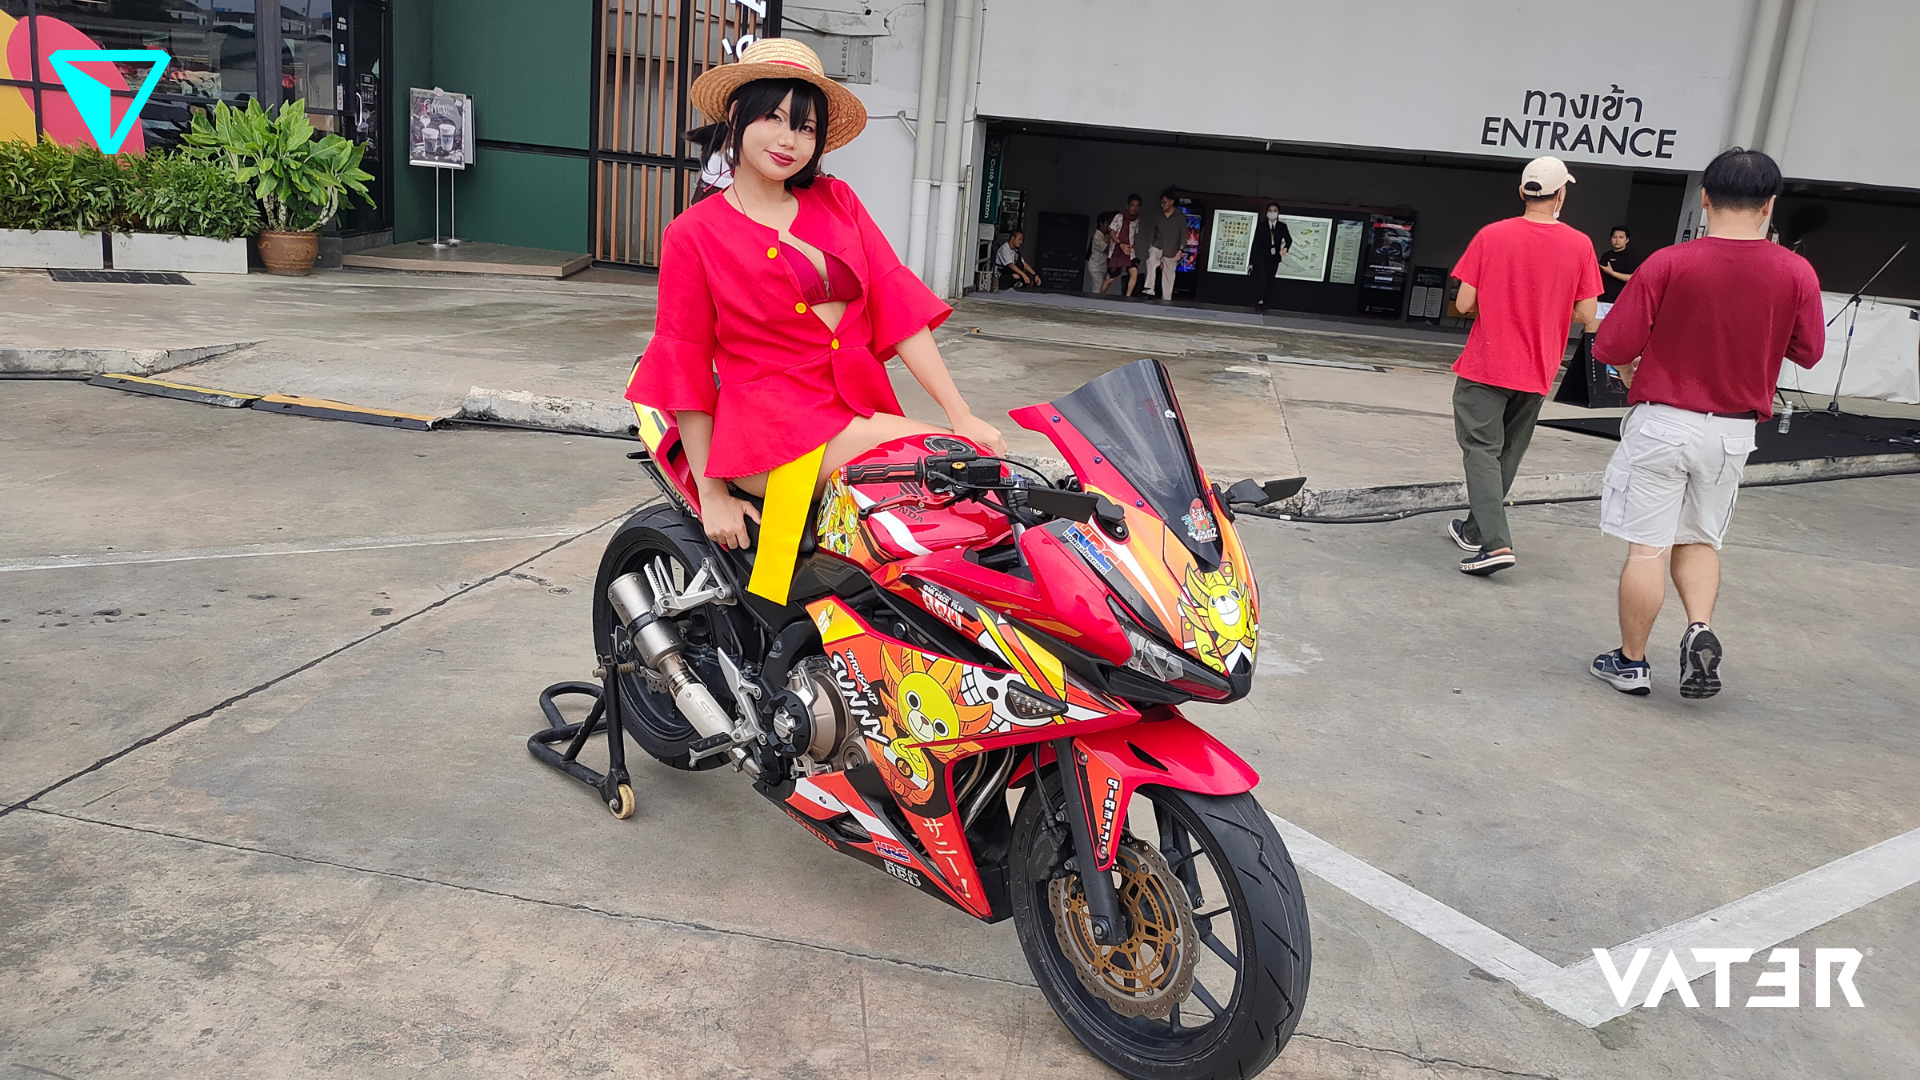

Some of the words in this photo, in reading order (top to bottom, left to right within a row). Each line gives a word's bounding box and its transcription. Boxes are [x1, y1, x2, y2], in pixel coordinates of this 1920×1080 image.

[1523, 84, 1643, 122] ทางเข้า
[1481, 117, 1677, 159] ENTRANCE
[984, 181, 995, 219] Amazon
[1063, 531, 1086, 553] HONDA
[1083, 549, 1108, 575] RACING
[950, 600, 965, 614] FILM
[844, 648, 879, 706] THOUSAND
[829, 654, 890, 744] SUNNY
[786, 809, 838, 850] HONDA
[874, 841, 910, 861] HRC
[886, 862, 922, 887] RED
